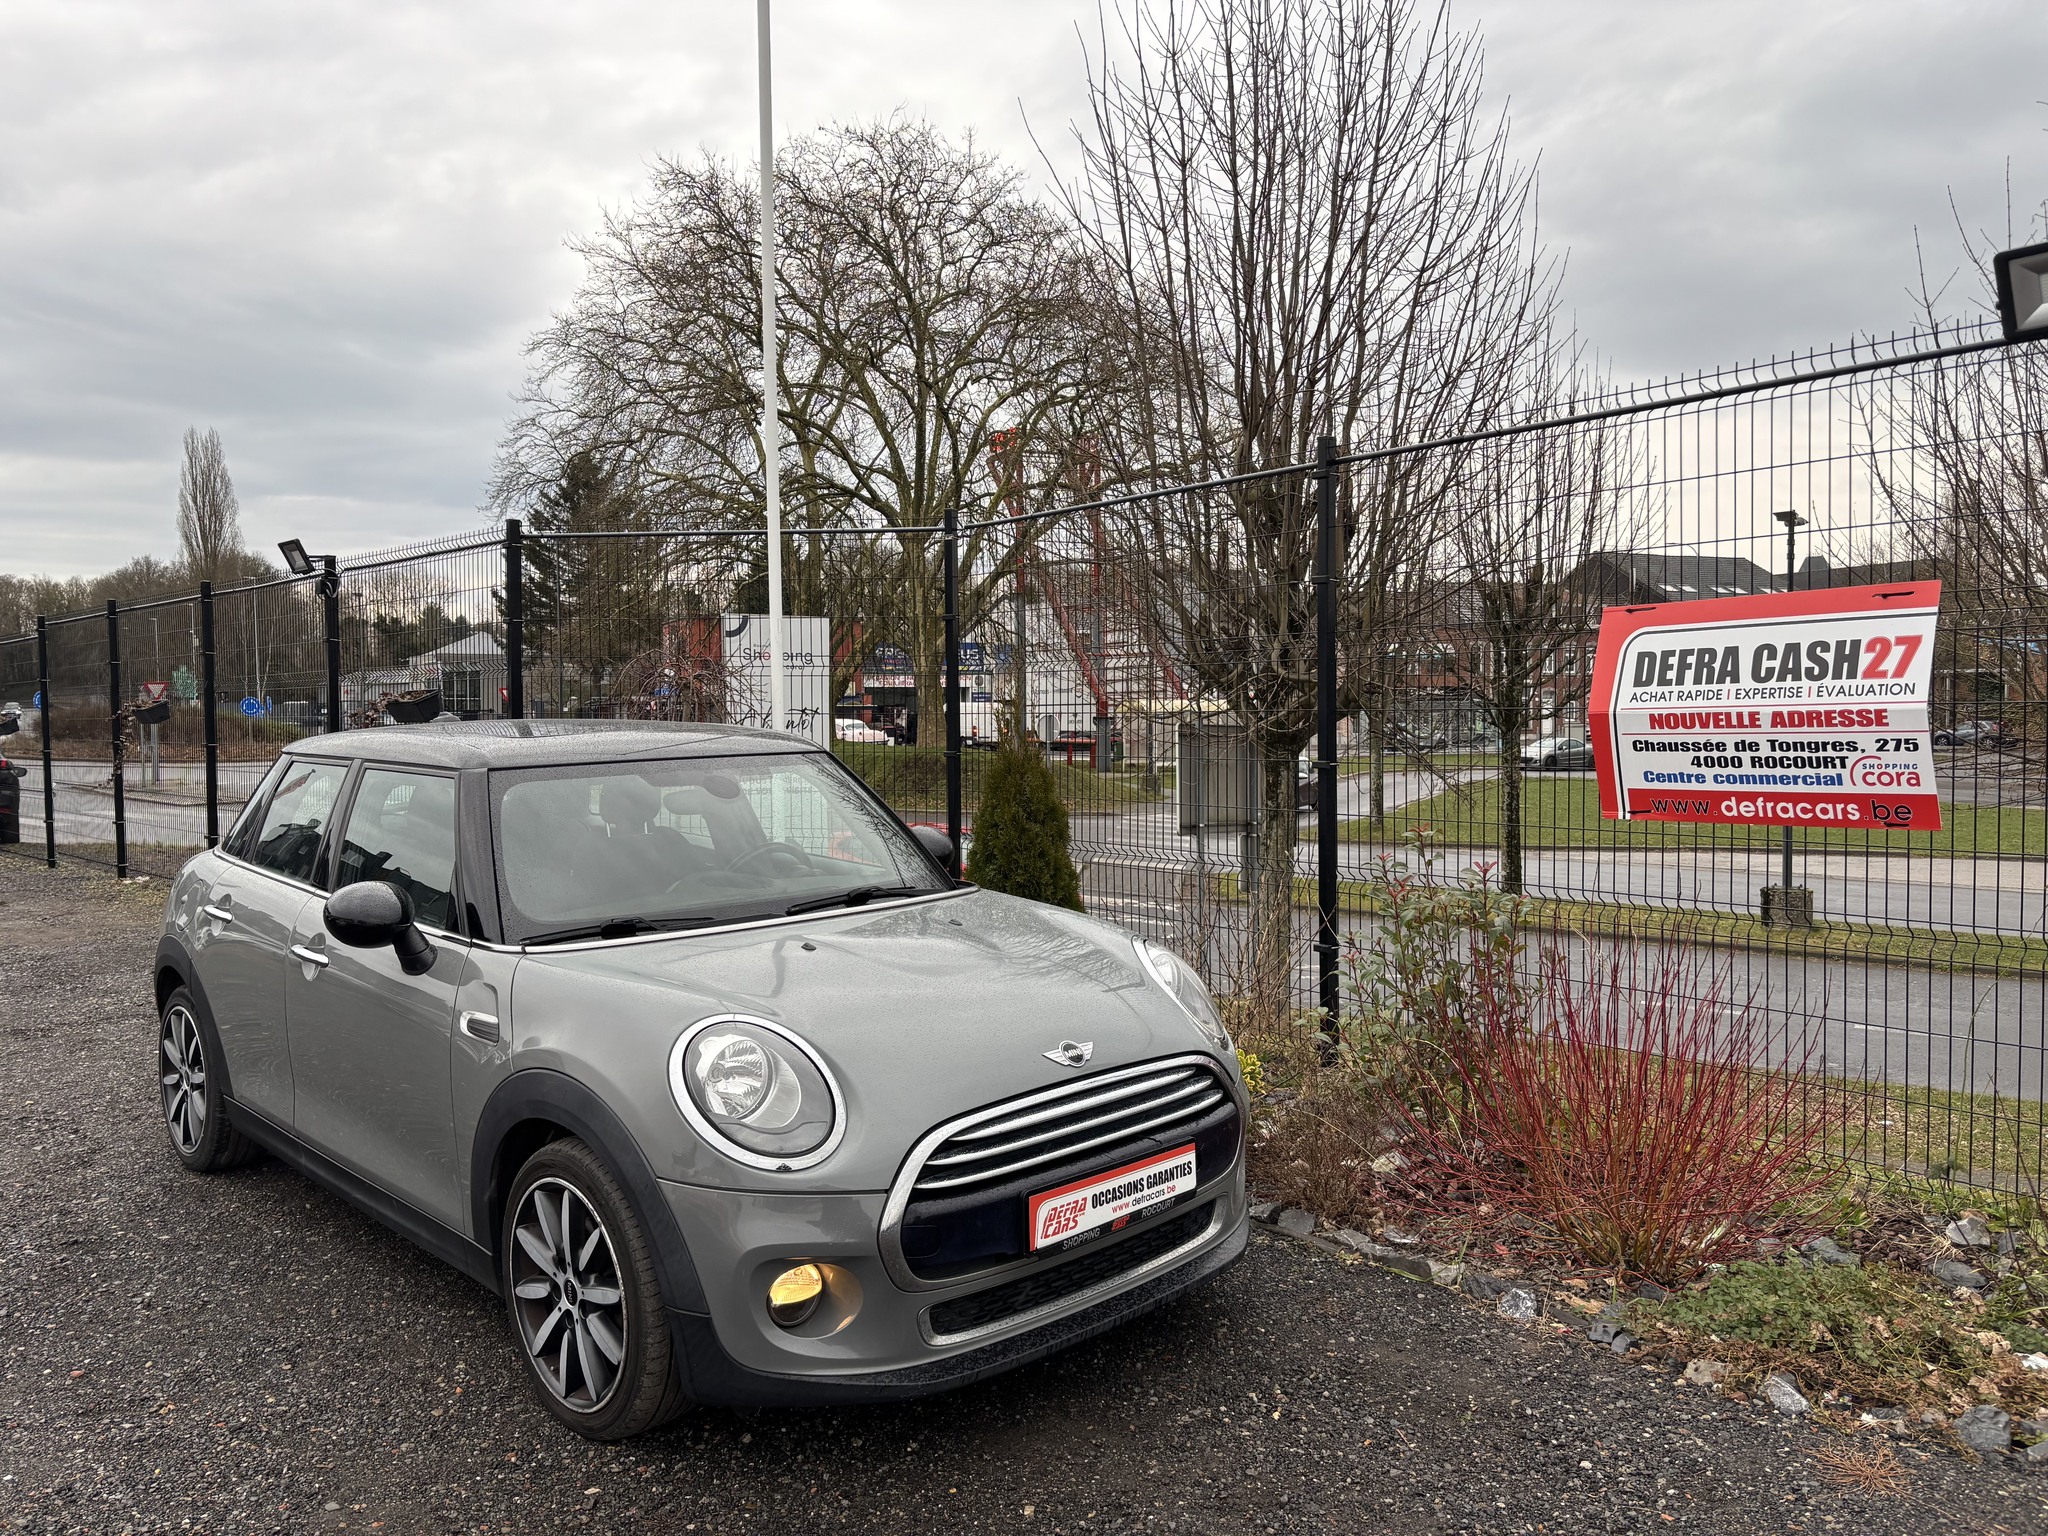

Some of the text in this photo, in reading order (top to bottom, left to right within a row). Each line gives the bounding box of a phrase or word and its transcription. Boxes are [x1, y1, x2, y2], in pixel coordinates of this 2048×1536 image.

[743, 647, 813, 665] Shoping
[1633, 645, 1741, 688] DEFRA
[1629, 682, 1917, 704] ACHAT RAPIDE EXPERTISE ÉVALUATION
[1649, 708, 1890, 730] NOUVELLE ADRESSE
[1632, 738, 1920, 754] Chaussée de Tongres, 275
[1690, 755, 1849, 770] 4000 ROCOURT
[1862, 763, 1919, 771] SHOPPING
[1643, 770, 1844, 787] Centre commercial
[1861, 770, 1922, 788] cora
[1063, 1047, 1083, 1059] MINI
[1091, 1160, 1193, 1210] OCCASIONS GARANTIES
[1047, 1196, 1088, 1223] DEFRA
[1141, 1197, 1176, 1219] ROCOURT
[1043, 1213, 1080, 1240] CARS
[1062, 1227, 1101, 1251] SHOPPING
